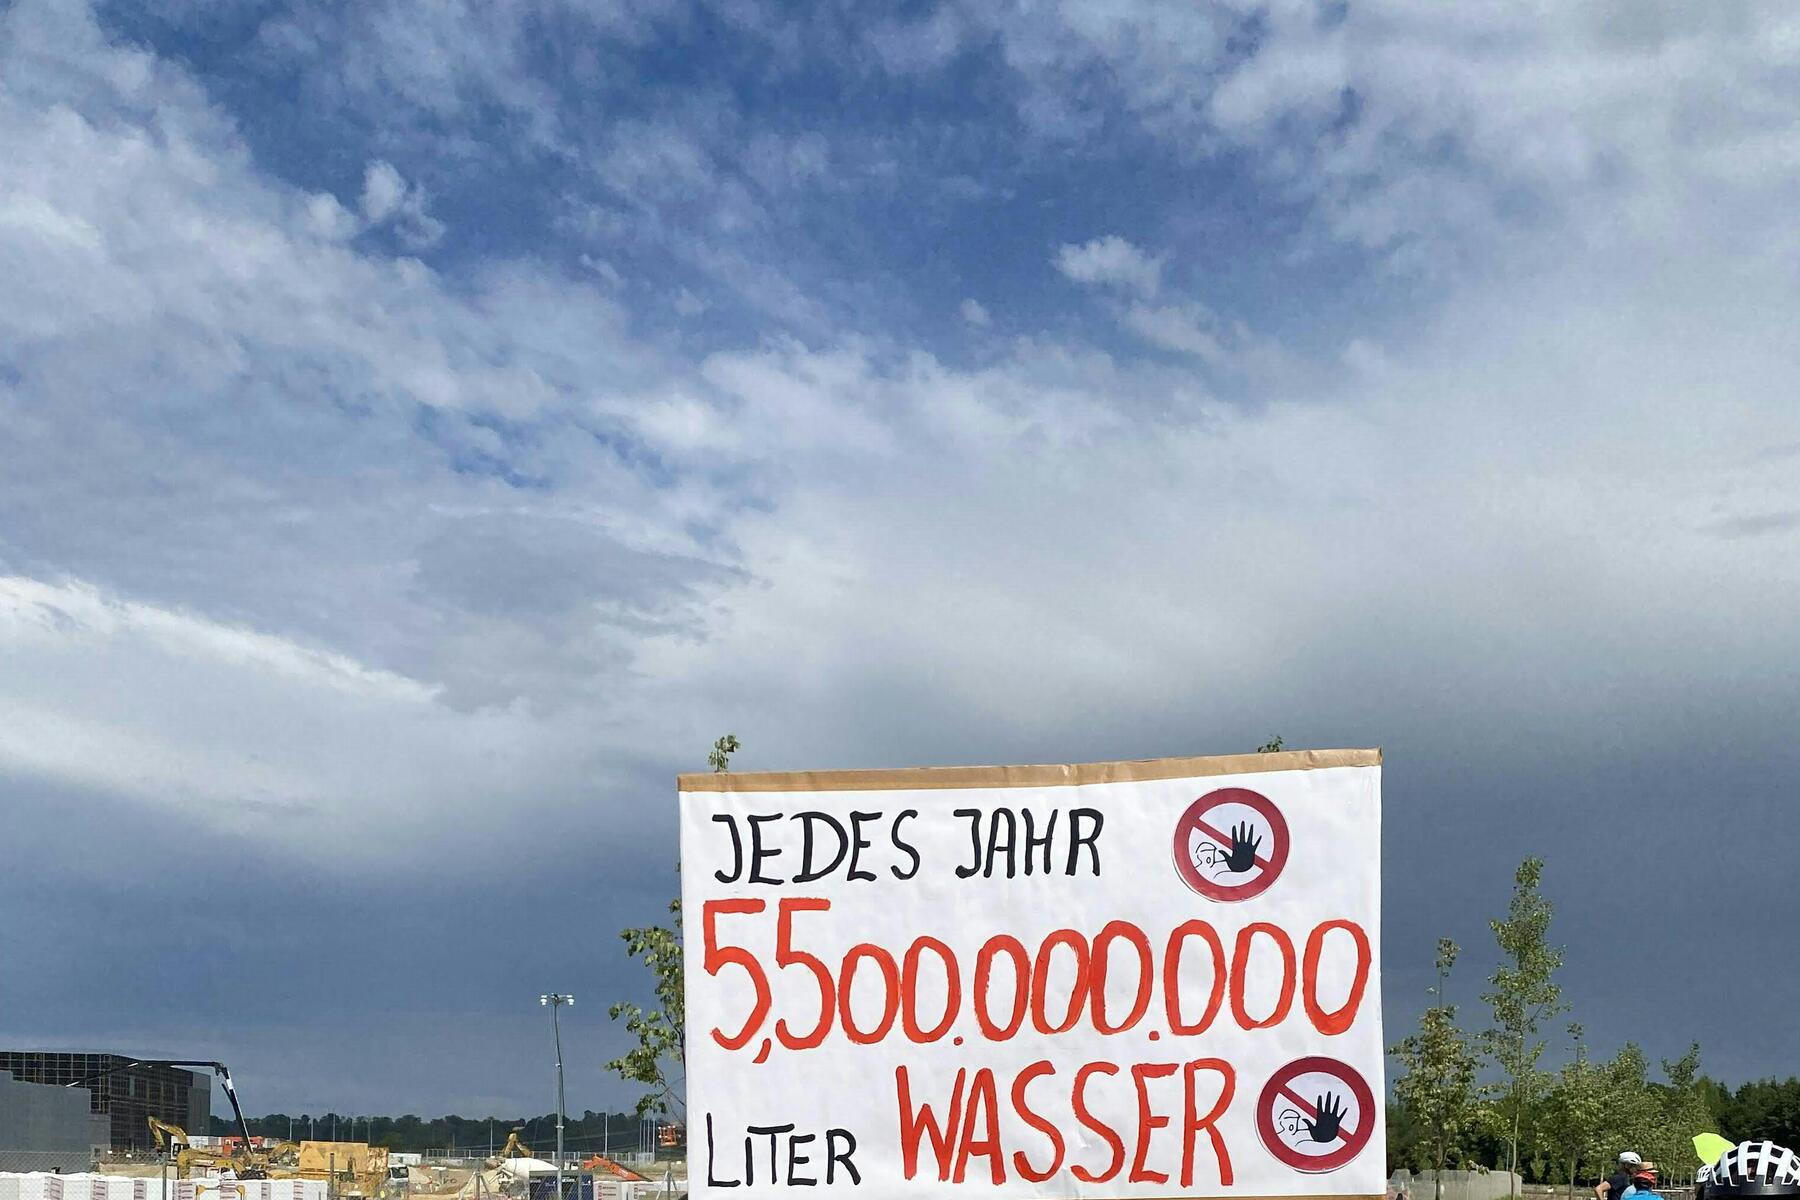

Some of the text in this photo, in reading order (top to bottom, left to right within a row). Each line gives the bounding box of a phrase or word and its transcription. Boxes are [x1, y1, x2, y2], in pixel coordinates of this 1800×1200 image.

[711, 807, 1104, 886] JEDES JAHR
[702, 897, 1372, 1064] 5,500.000.000
[706, 1057, 1236, 1188] LITER WASSER
